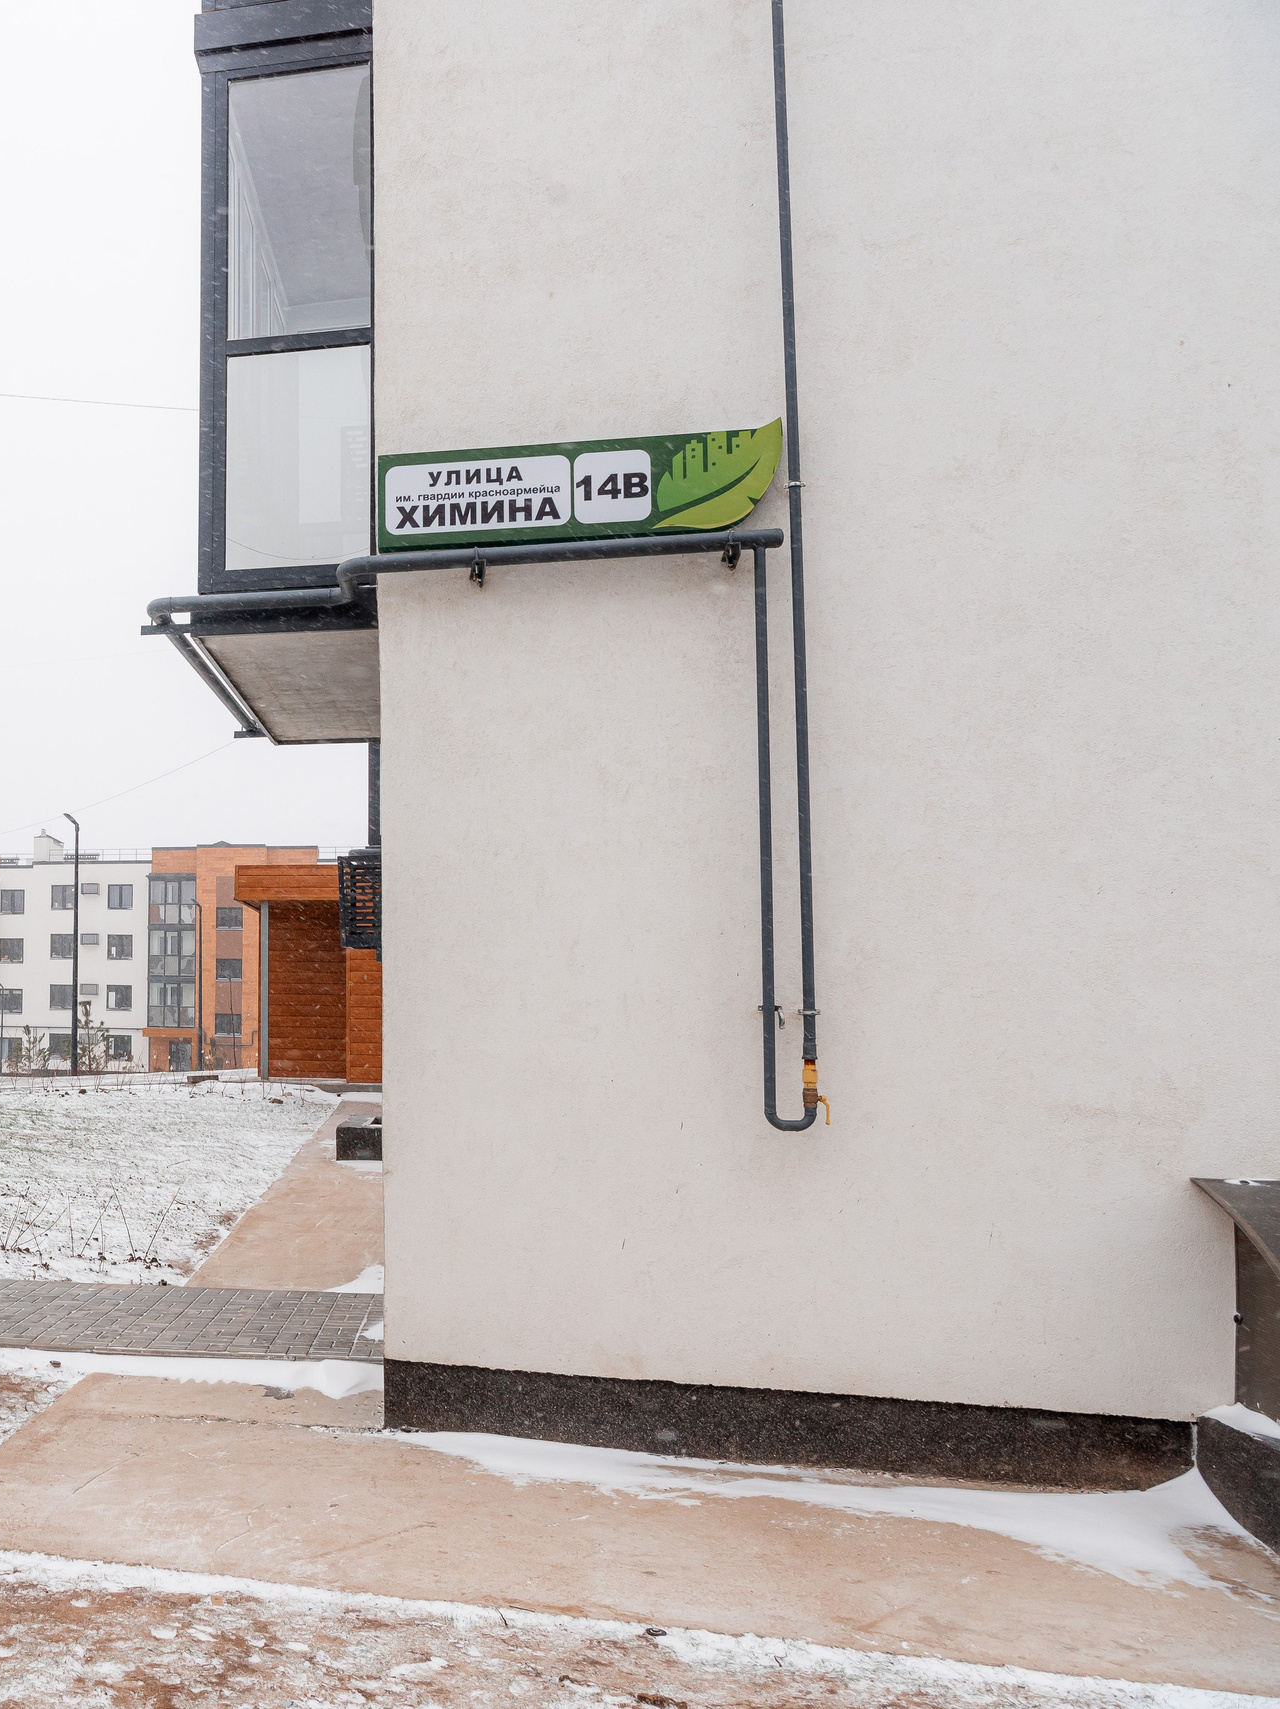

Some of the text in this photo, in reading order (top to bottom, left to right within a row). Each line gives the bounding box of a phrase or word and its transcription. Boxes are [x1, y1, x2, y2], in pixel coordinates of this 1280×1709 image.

[428, 466, 523, 487] УЛИЦА
[576, 473, 649, 501] 14В
[396, 485, 561, 503] им. гвардии красноармейца
[396, 497, 561, 529] ХИМИНА
